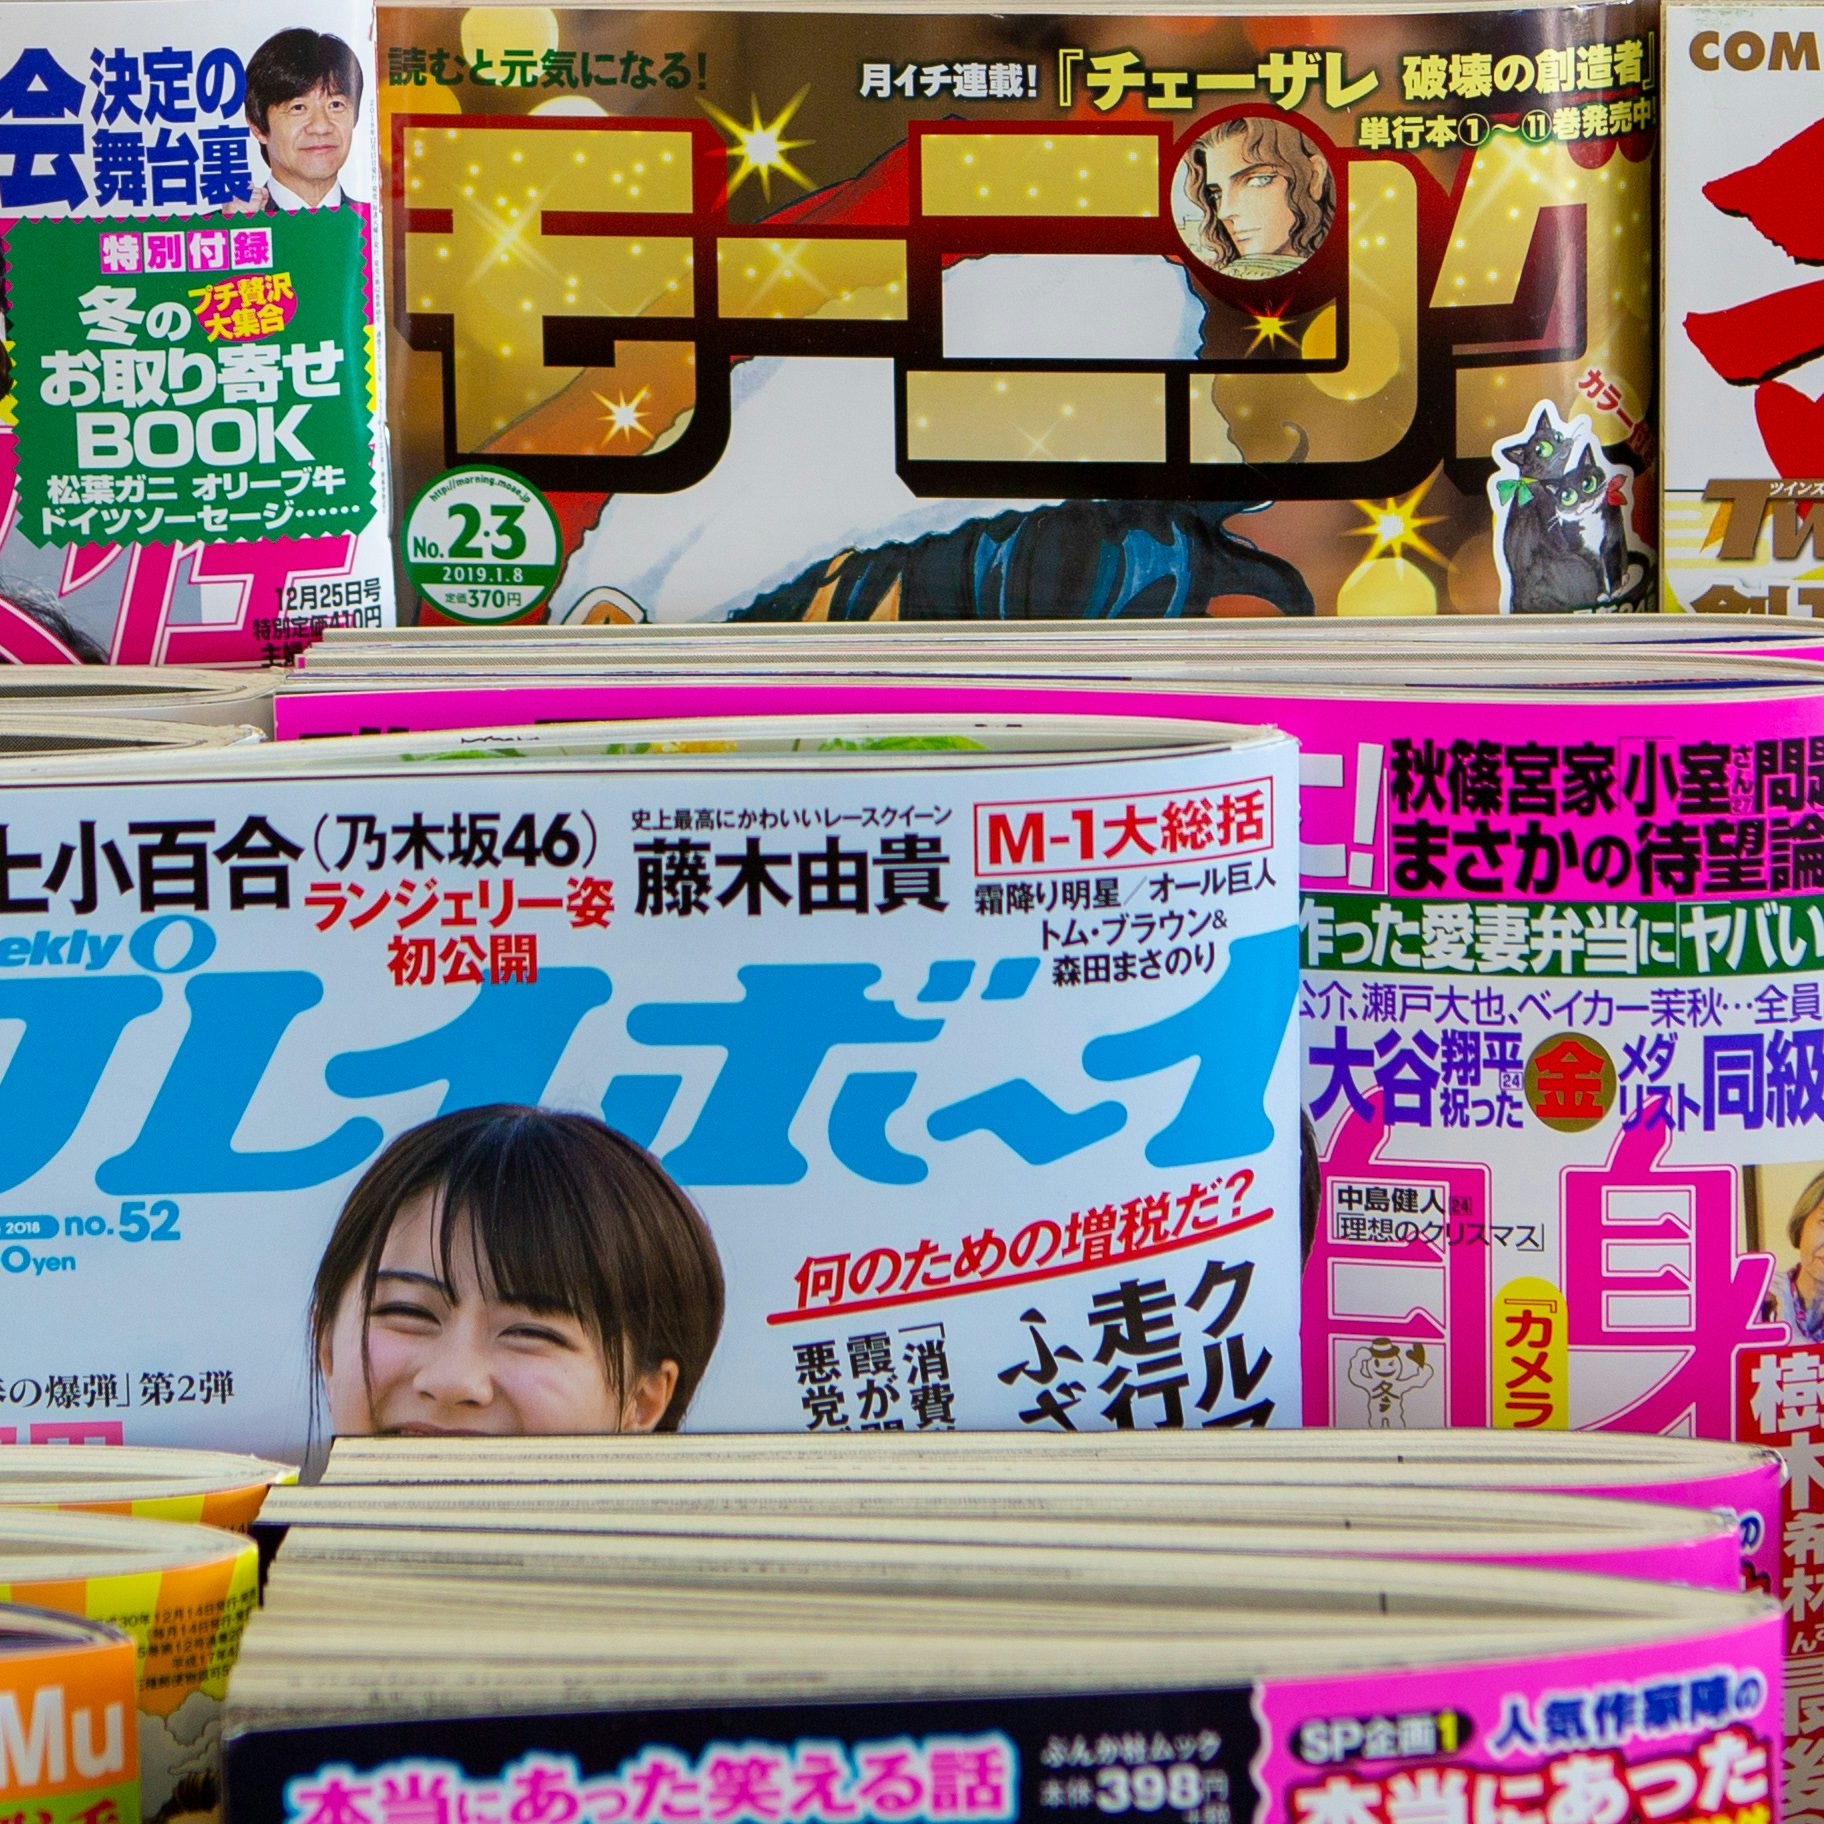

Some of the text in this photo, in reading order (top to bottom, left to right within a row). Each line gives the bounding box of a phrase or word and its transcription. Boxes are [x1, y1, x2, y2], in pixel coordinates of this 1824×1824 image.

[90, 46, 247, 126] 決定の
[91, 126, 254, 207] 舞台裏
[100, 232, 274, 272] 特別付録
[202, 306, 286, 342] 大集合
[40, 342, 344, 410] お取り寄せ
[77, 410, 317, 469] BOOK
[46, 466, 347, 506] 松葉ガニ オリーブ牛
[441, 565, 523, 584] 2019.1.8
[444, 586, 522, 610] 定価370円
[631, 804, 953, 833] 史上最高にかわいいレースクイーン
[986, 788, 1266, 867] M-1大総括
[633, 832, 951, 918] 藤木由貴
[386, 933, 540, 987] 初公開
[1051, 941, 1218, 987] 森田まさのり
[1308, 1024, 1441, 1130] 大谷
[64, 1200, 181, 1242] no.52
[1336, 1184, 1445, 1215] 中島健人
[4, 1221, 42, 1236] 2018
